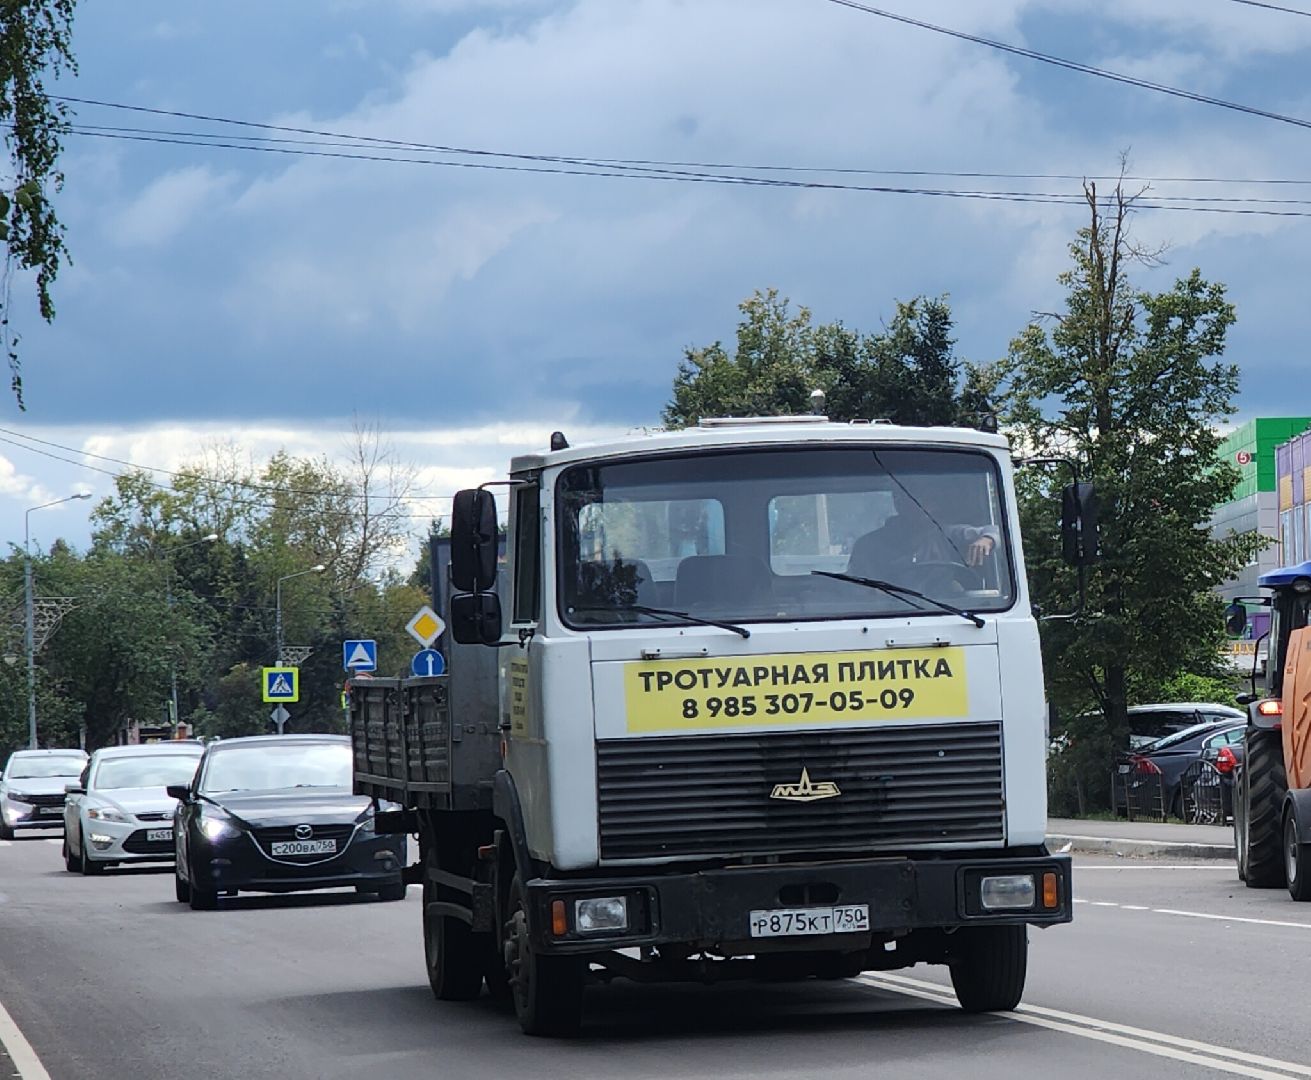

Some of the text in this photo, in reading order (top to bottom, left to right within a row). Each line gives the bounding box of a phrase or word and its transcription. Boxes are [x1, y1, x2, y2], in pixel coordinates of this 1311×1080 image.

[638, 658, 953, 693] ТРОТУАРНАЯ ПЛИТКА
[682, 688, 915, 719] 8 985 307-05-09
[757, 908, 863, 934] Р875КТ 750
